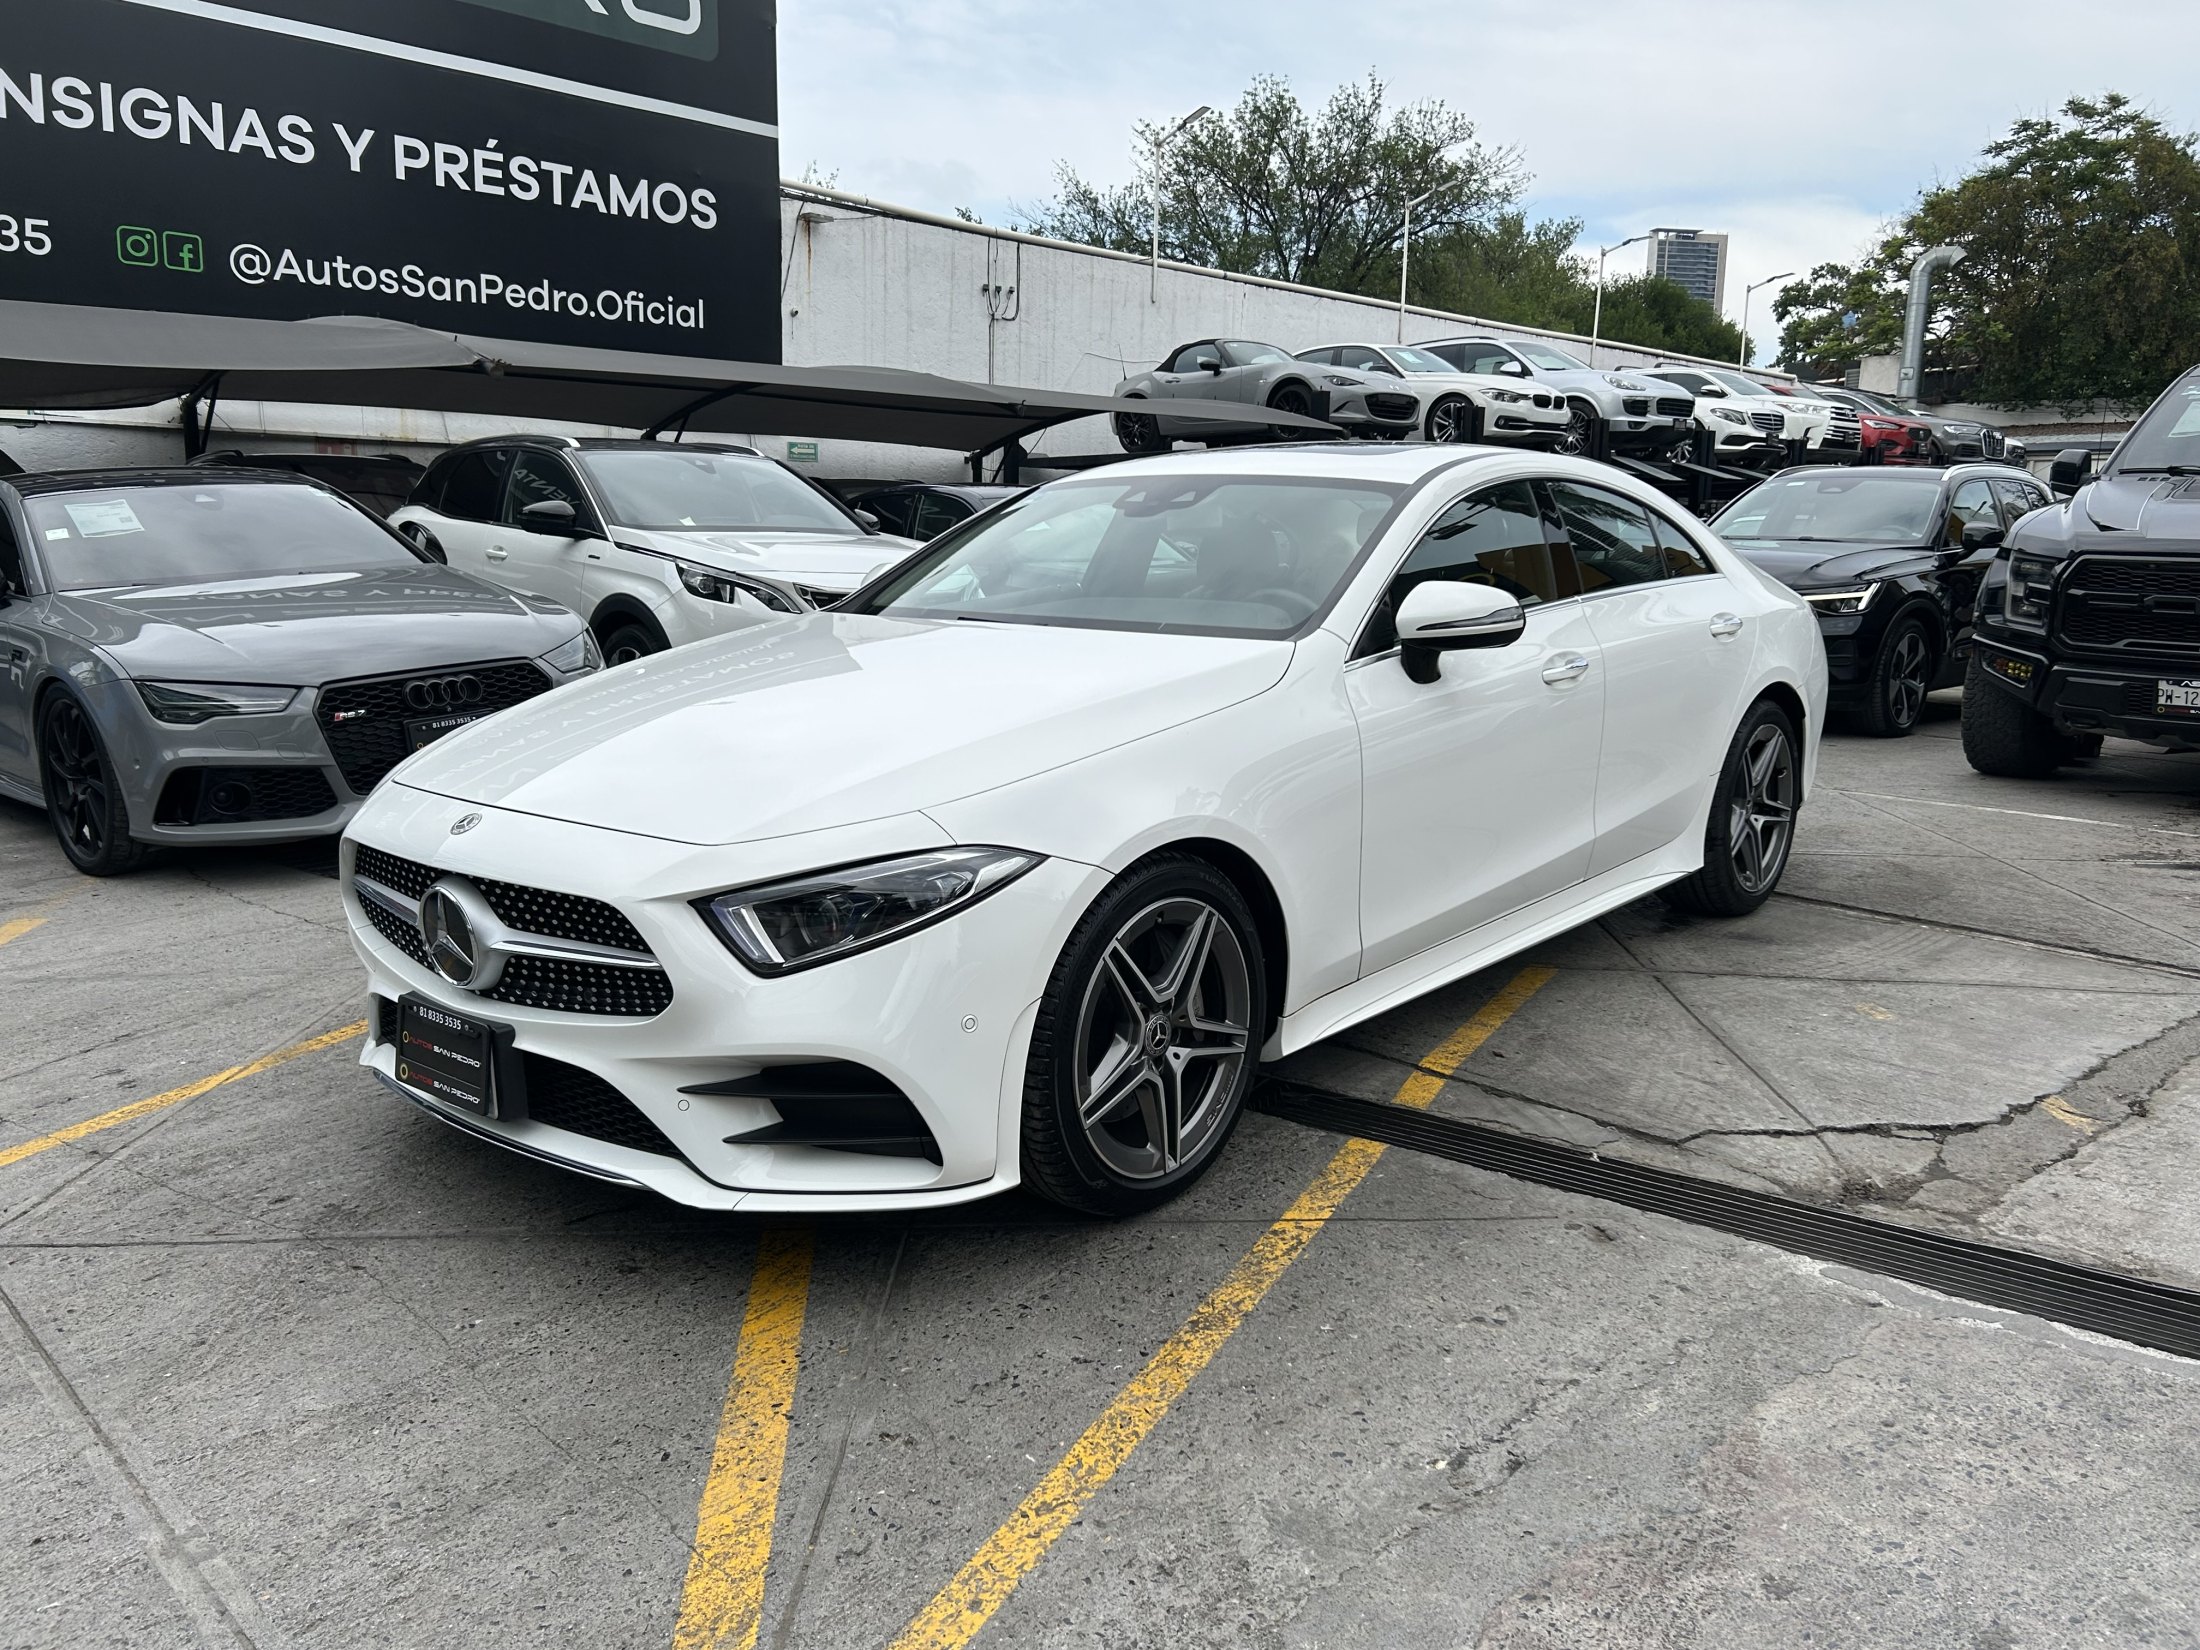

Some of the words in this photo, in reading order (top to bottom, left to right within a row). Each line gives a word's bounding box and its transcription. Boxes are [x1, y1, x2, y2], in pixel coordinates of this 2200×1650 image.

[332, 123, 376, 173] Y
[394, 135, 719, 231] PRÉSTAMOS
[229, 243, 705, 330] @AutosSanPedro.Oficial
[419, 1006, 428, 1018] 81
[428, 1009, 444, 1024] 8335
[444, 1015, 462, 1030] 3535
[410, 1036, 433, 1050] AUTOS
[433, 1045, 451, 1058] SAN
[451, 1051, 480, 1068] PEDRO
[433, 1081, 451, 1094] SAN
[451, 1088, 480, 1104] PEDRO
